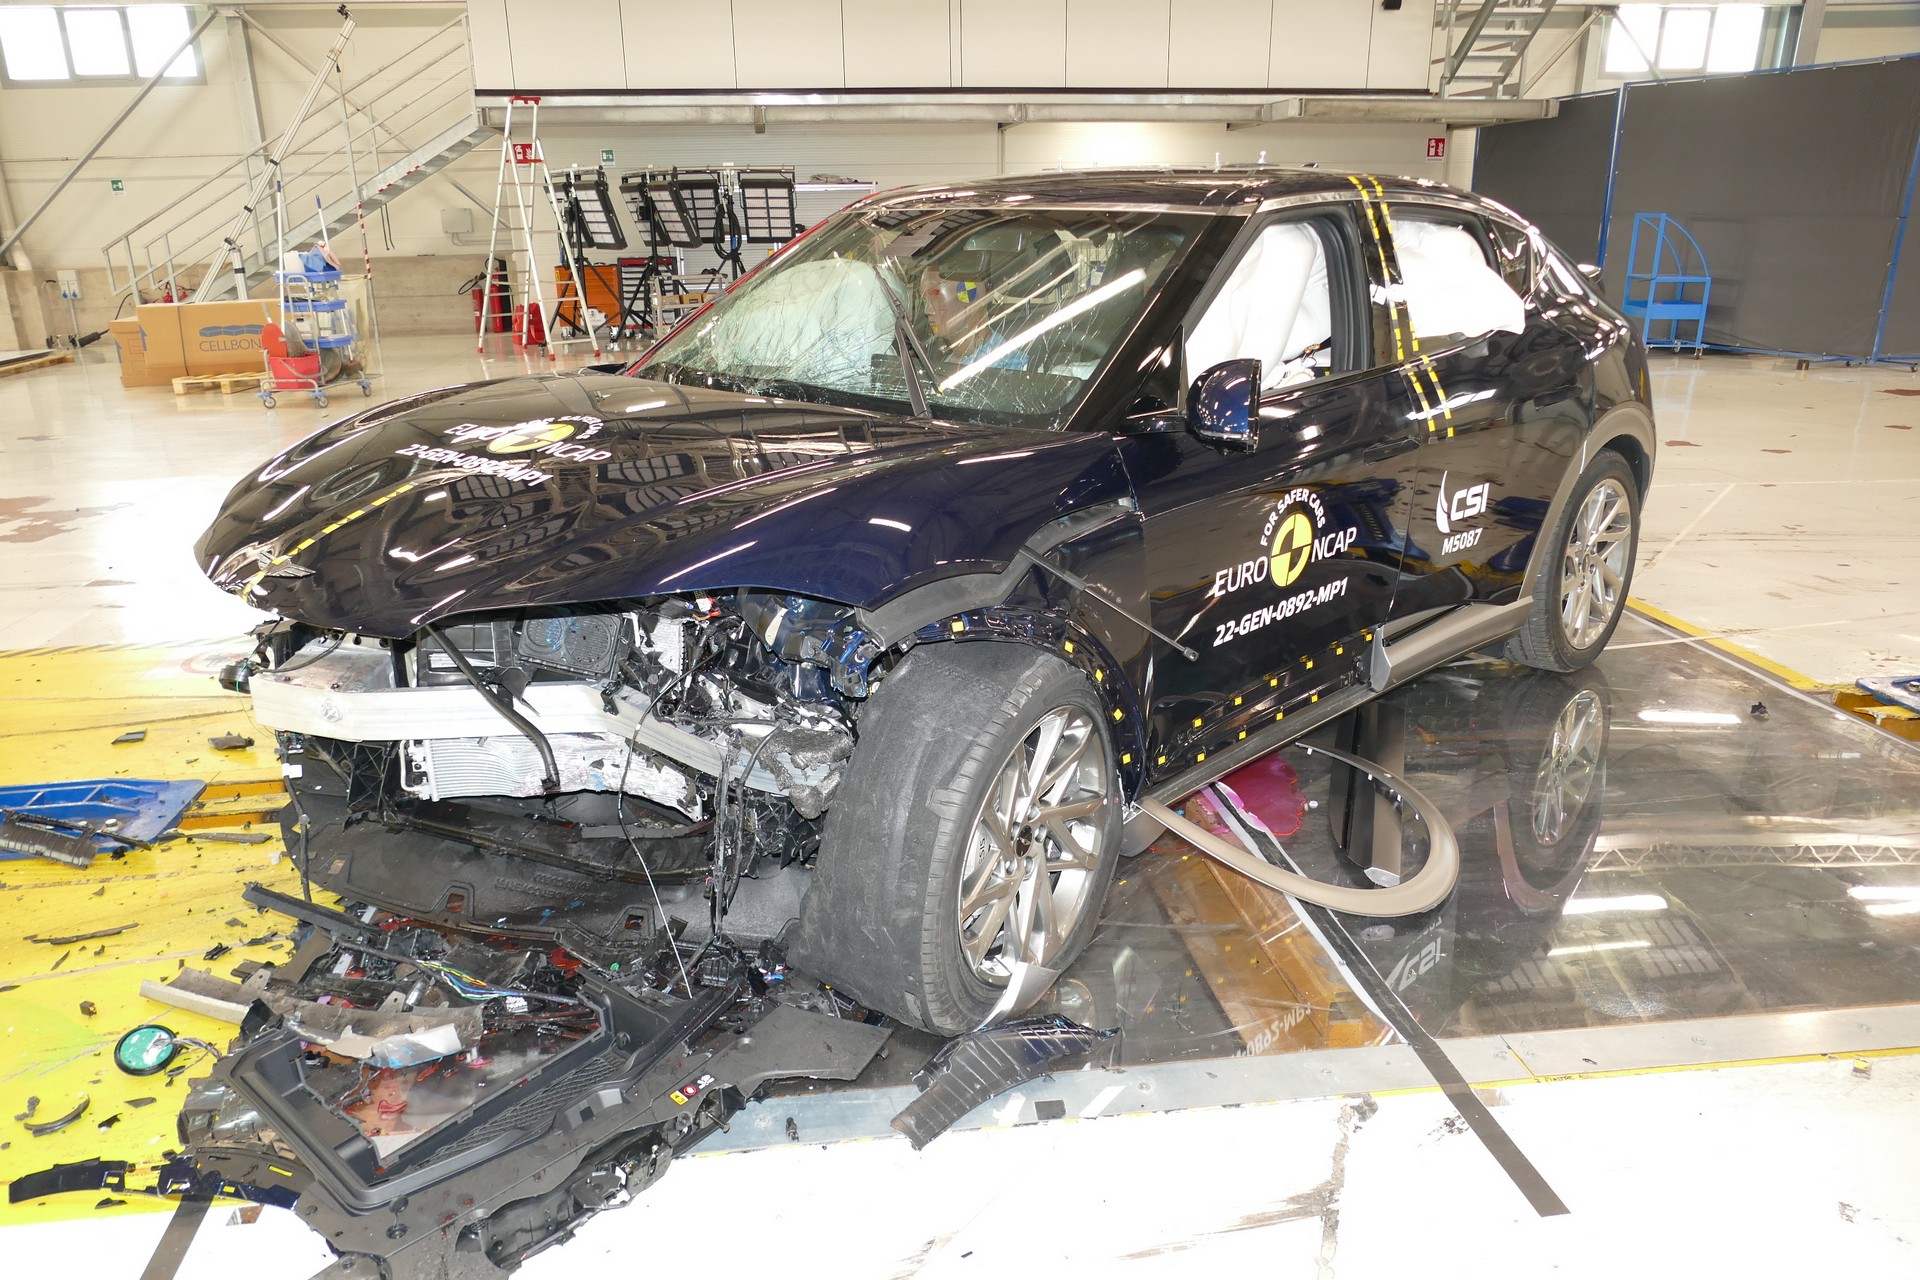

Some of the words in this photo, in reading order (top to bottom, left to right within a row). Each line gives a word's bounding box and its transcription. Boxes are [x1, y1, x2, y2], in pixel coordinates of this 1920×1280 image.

[199, 338, 263, 352] CELLBON
[537, 441, 612, 462] NCAP
[1260, 511, 1279, 547] FOR
[1277, 488, 1310, 514] SAFER
[1309, 493, 1326, 529] CARS
[1450, 482, 1490, 521] CSI
[1442, 527, 1483, 556] M5087
[1214, 556, 1268, 598] EURO
[1311, 527, 1358, 563] NCAP
[1213, 576, 1349, 648] 22-GEN-0892-MP1
